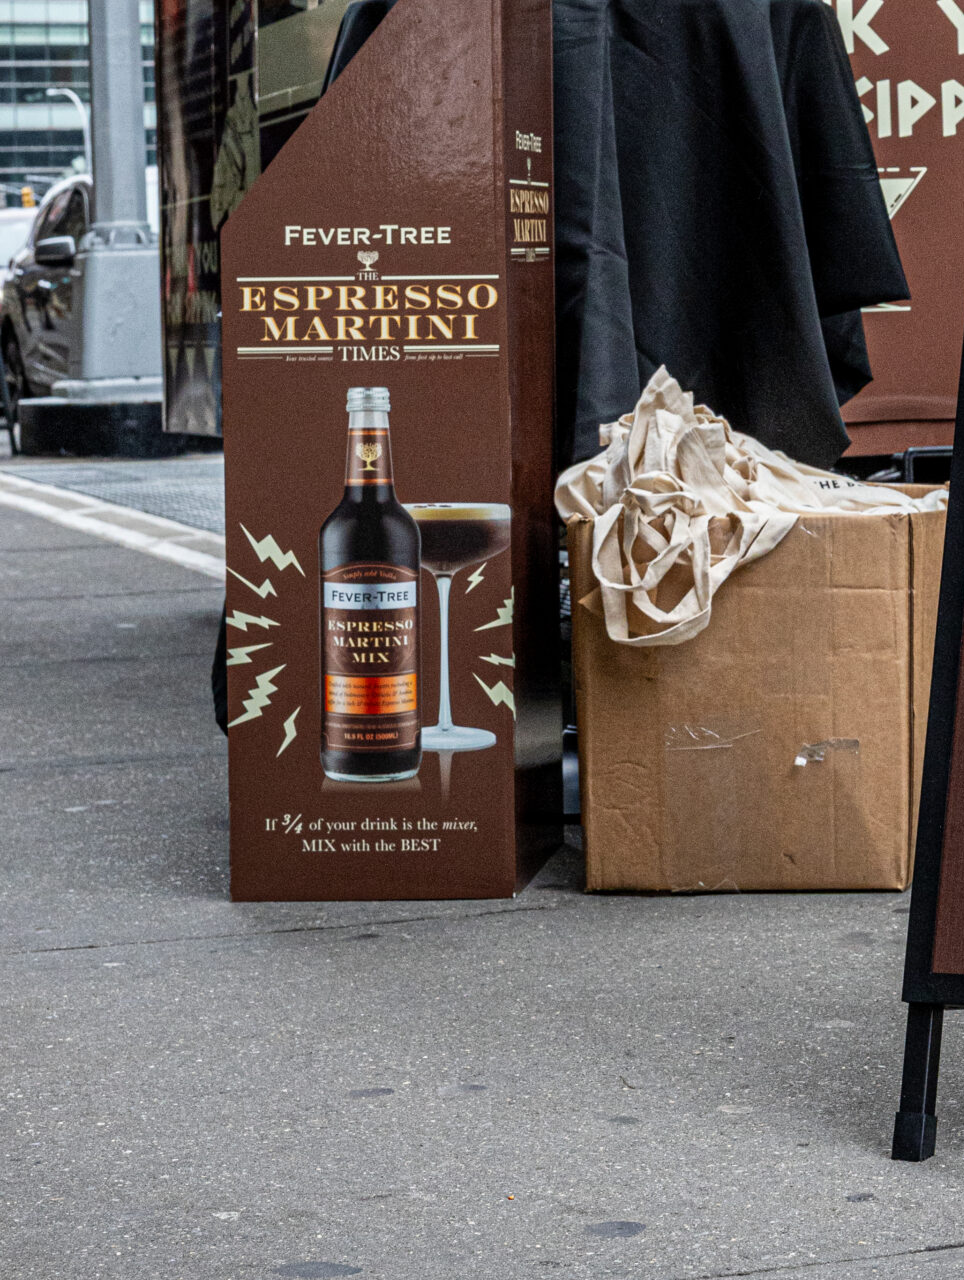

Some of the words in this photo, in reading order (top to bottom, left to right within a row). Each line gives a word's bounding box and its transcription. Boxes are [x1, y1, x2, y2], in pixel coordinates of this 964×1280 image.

[509, 188, 550, 214] ESPRESSO
[284, 225, 452, 246] FEVER-TREE
[513, 218, 547, 242] MARTINI
[356, 271, 380, 281] THE
[238, 282, 500, 312] ESPRESSO
[259, 313, 480, 342] MARTINI
[337, 345, 401, 362] TIMES
[331, 589, 409, 603] FEVER-TREE
[328, 619, 414, 633] ESPRESSO
[333, 634, 409, 648] MARTINI
[352, 652, 390, 664] MIX
[265, 818, 278, 831] If
[309, 818, 325, 831] of
[326, 820, 357, 834] your
[361, 818, 398, 831] drink
[402, 818, 413, 831] is
[417, 818, 438, 831] the
[442, 818, 479, 832] mixer,
[302, 839, 337, 852] MIX
[341, 839, 370, 852] with
[375, 839, 396, 852] the
[401, 838, 442, 852] BEST
